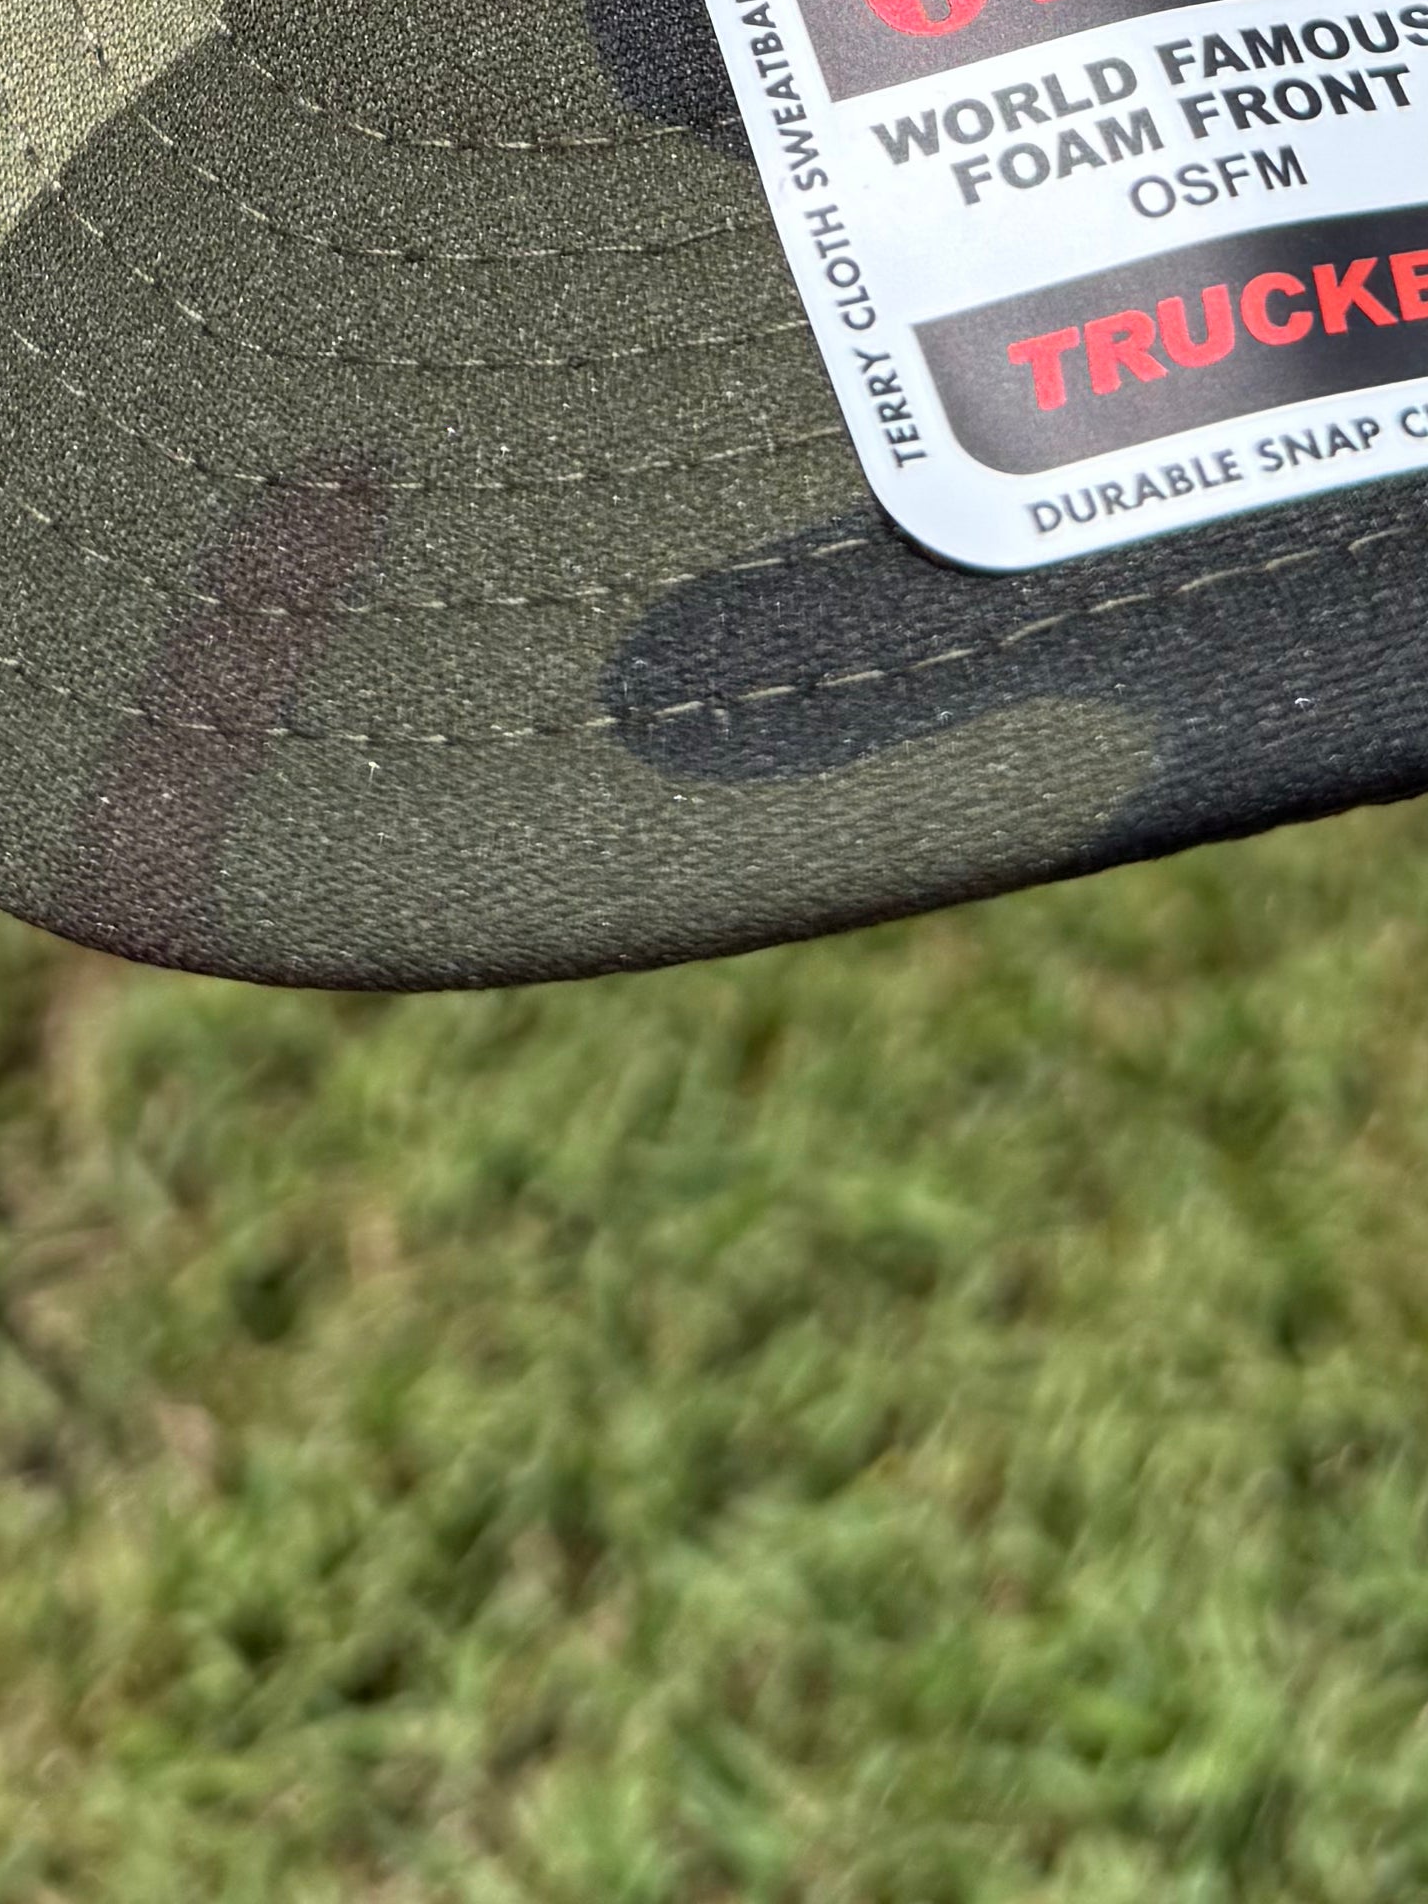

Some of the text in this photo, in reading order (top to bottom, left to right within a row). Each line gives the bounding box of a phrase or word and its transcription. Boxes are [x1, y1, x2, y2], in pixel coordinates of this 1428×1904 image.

[870, 54, 1139, 169] WORLD
[951, 63, 1414, 207] FOAM FRONT
[1129, 145, 1309, 221] OSFM
[803, 202, 879, 333] CLOTH
[852, 344, 929, 469] TERRY
[1028, 443, 1245, 538] DURABLE
[1261, 417, 1383, 476] SNAP
